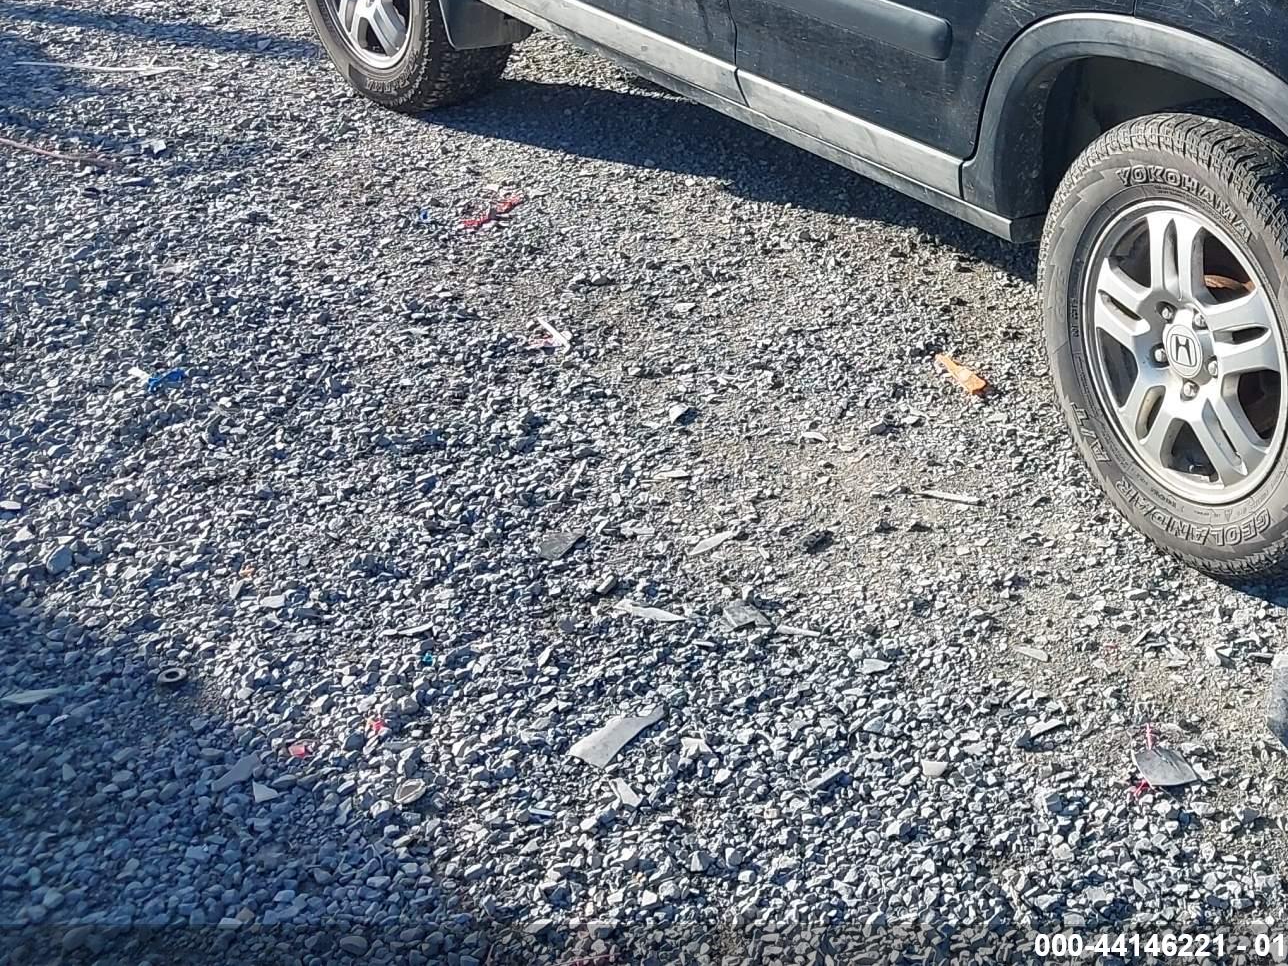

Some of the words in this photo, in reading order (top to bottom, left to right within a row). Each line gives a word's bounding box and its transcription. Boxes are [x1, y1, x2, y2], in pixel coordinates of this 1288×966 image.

[1115, 164, 1252, 242] YOKOHAMA
[1070, 402, 1112, 463] A/T
[1116, 475, 1271, 546] GEOLANDAR
